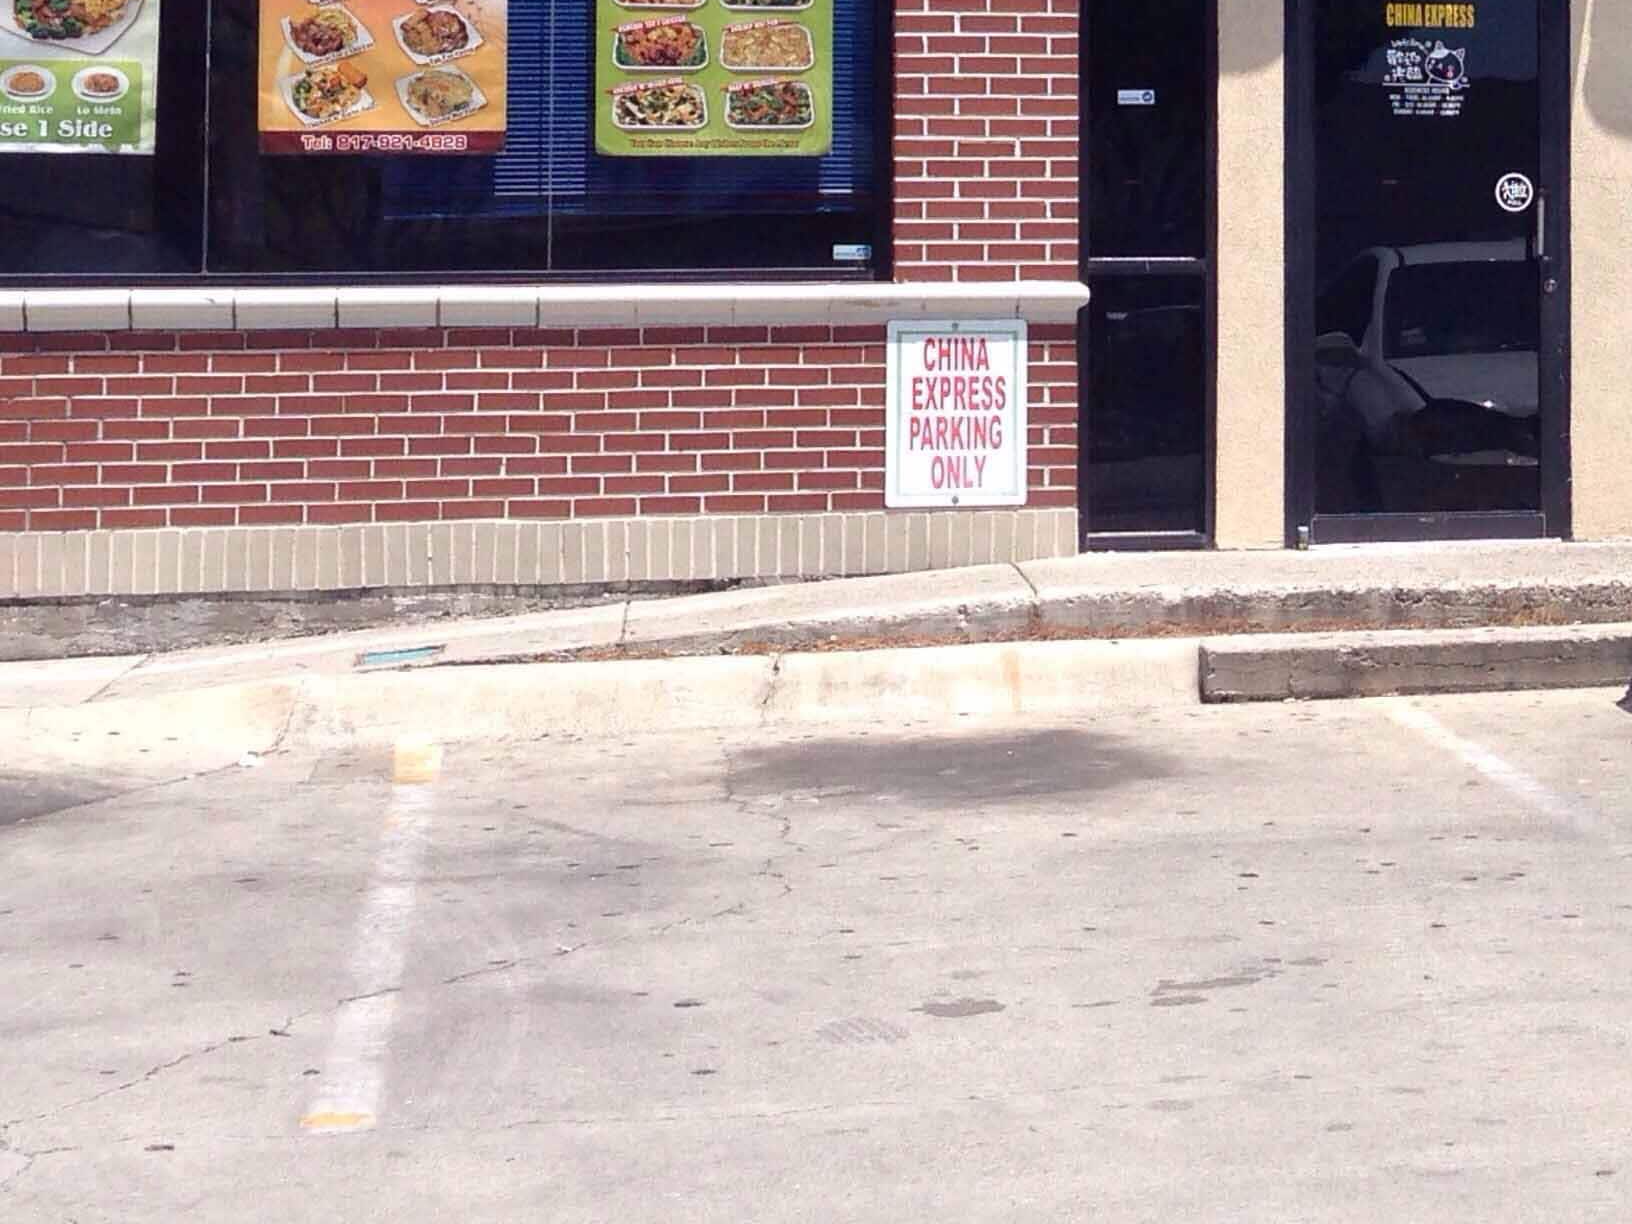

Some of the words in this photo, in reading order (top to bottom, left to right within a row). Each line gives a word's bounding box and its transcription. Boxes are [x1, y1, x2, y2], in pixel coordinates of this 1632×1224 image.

[1386, 3, 1422, 27] CHINA
[1424, 4, 1475, 28] EXPRESS
[0, 104, 26, 114] ried
[28, 105, 54, 114] Rice
[57, 120, 113, 138] Side
[301, 134, 333, 150] Tel:
[336, 134, 467, 150] 817-921-4828
[923, 337, 990, 371] CHINA
[911, 375, 1006, 410] EXPRESS
[909, 415, 1002, 450] PARKING
[930, 455, 986, 489] ONLY
